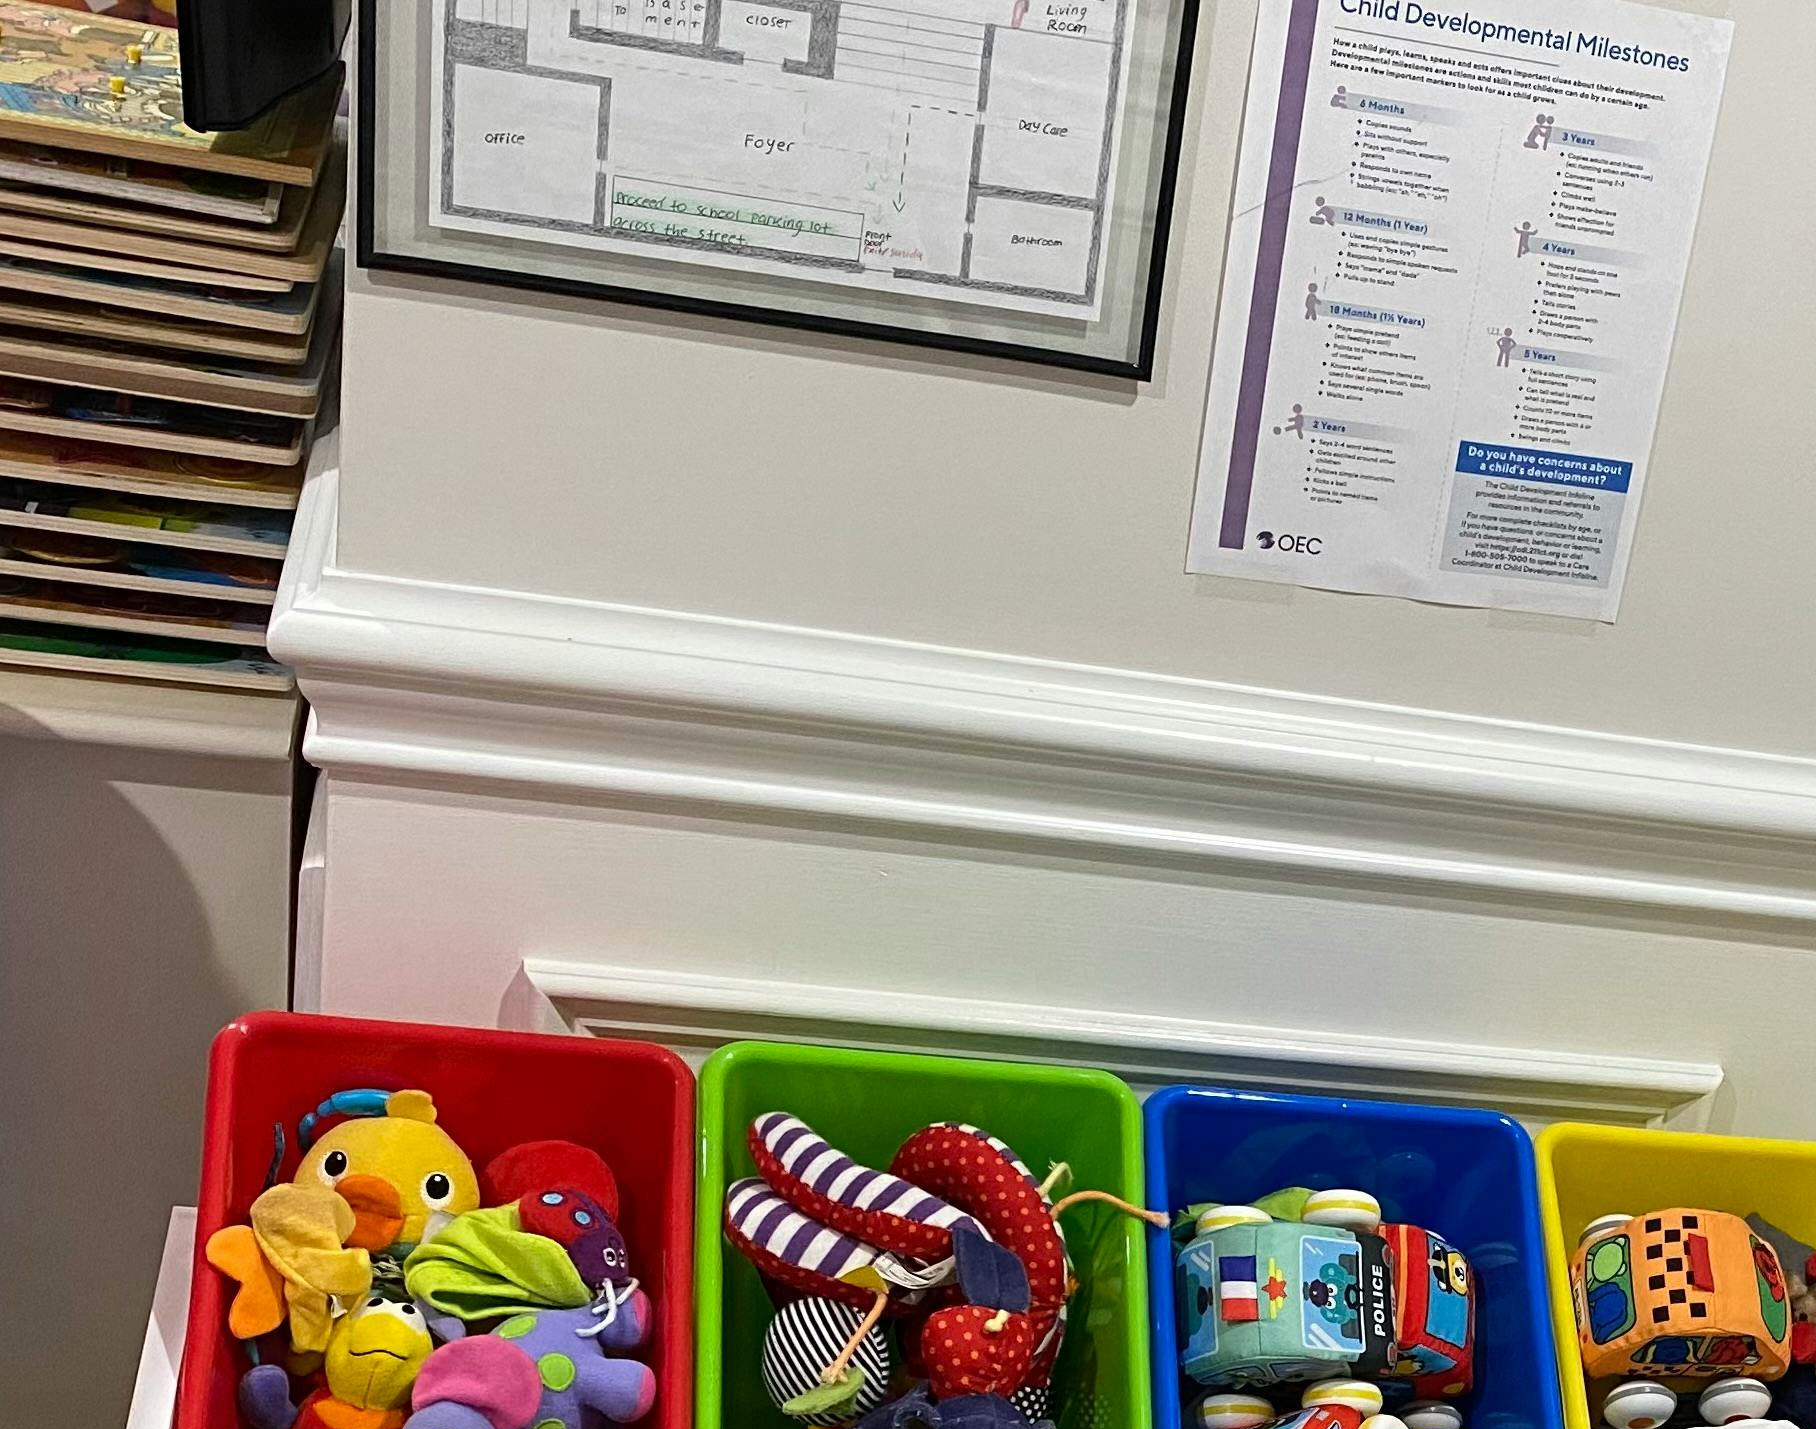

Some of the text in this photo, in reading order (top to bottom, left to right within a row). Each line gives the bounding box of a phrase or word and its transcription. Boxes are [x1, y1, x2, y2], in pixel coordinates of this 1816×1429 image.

[1046, 4, 1087, 21] Living
[1047, 19, 1087, 34] Room
[1339, 0, 1691, 72] Child Developmental Milestones
[1333, 37, 1351, 47] How
[1358, 41, 1377, 51] child
[1402, 49, 1429, 62] learns,
[1429, 54, 1456, 66] speaks
[1457, 58, 1472, 67] and
[1489, 64, 1512, 74] offers
[1513, 68, 1551, 82] important
[1572, 78, 1594, 88] about
[1595, 82, 1614, 92] their
[1330, 59, 1348, 69] Here
[1370, 66, 1384, 75] few
[1385, 69, 1424, 83] important
[1425, 75, 1456, 87] markers
[1467, 82, 1483, 92] look
[1484, 85, 1496, 94] for
[1512, 90, 1531, 100] child
[1331, 48, 1390, 67] Developmental
[1391, 58, 1433, 72] milestones
[1448, 68, 1476, 79] actions
[1477, 73, 1491, 82] and
[1512, 79, 1532, 89] most
[1533, 82, 1563, 94] children
[1606, 95, 1633, 106] certain
[1360, 99, 1403, 112] 6 Months
[1018, 119, 1068, 137] Day Care
[745, 134, 795, 154] Foyer
[1562, 132, 1594, 145] 3 Years
[613, 215, 655, 233] across
[664, 224, 688, 237] the
[670, 201, 688, 213] to
[696, 205, 739, 221] school
[810, 222, 832, 234] lot
[1344, 212, 1427, 234] 12 Months (1 Year)
[1011, 235, 1063, 246] Bathroom
[1551, 243, 1574, 255] Years
[1342, 307, 1376, 319] Months
[1397, 314, 1425, 328] Years)
[1532, 350, 1555, 361] Years
[1321, 421, 1345, 432] Years
[1468, 445, 1621, 475] Do you have concerns about
[1489, 462, 1524, 474] child's
[1527, 466, 1606, 484] development?
[1485, 480, 1498, 488] The
[1499, 482, 1518, 490] Child
[1520, 485, 1567, 496] Development
[1507, 494, 1546, 503] information
[1568, 523, 1577, 532] by
[1278, 535, 1323, 556] OEC
[1531, 538, 1561, 547] behavior
[1577, 534, 1597, 542] about
[1503, 563, 1522, 571] Child
[1523, 565, 1569, 576] Development
[1573, 562, 1588, 570] Care
[1371, 1264, 1386, 1337] POLICE
